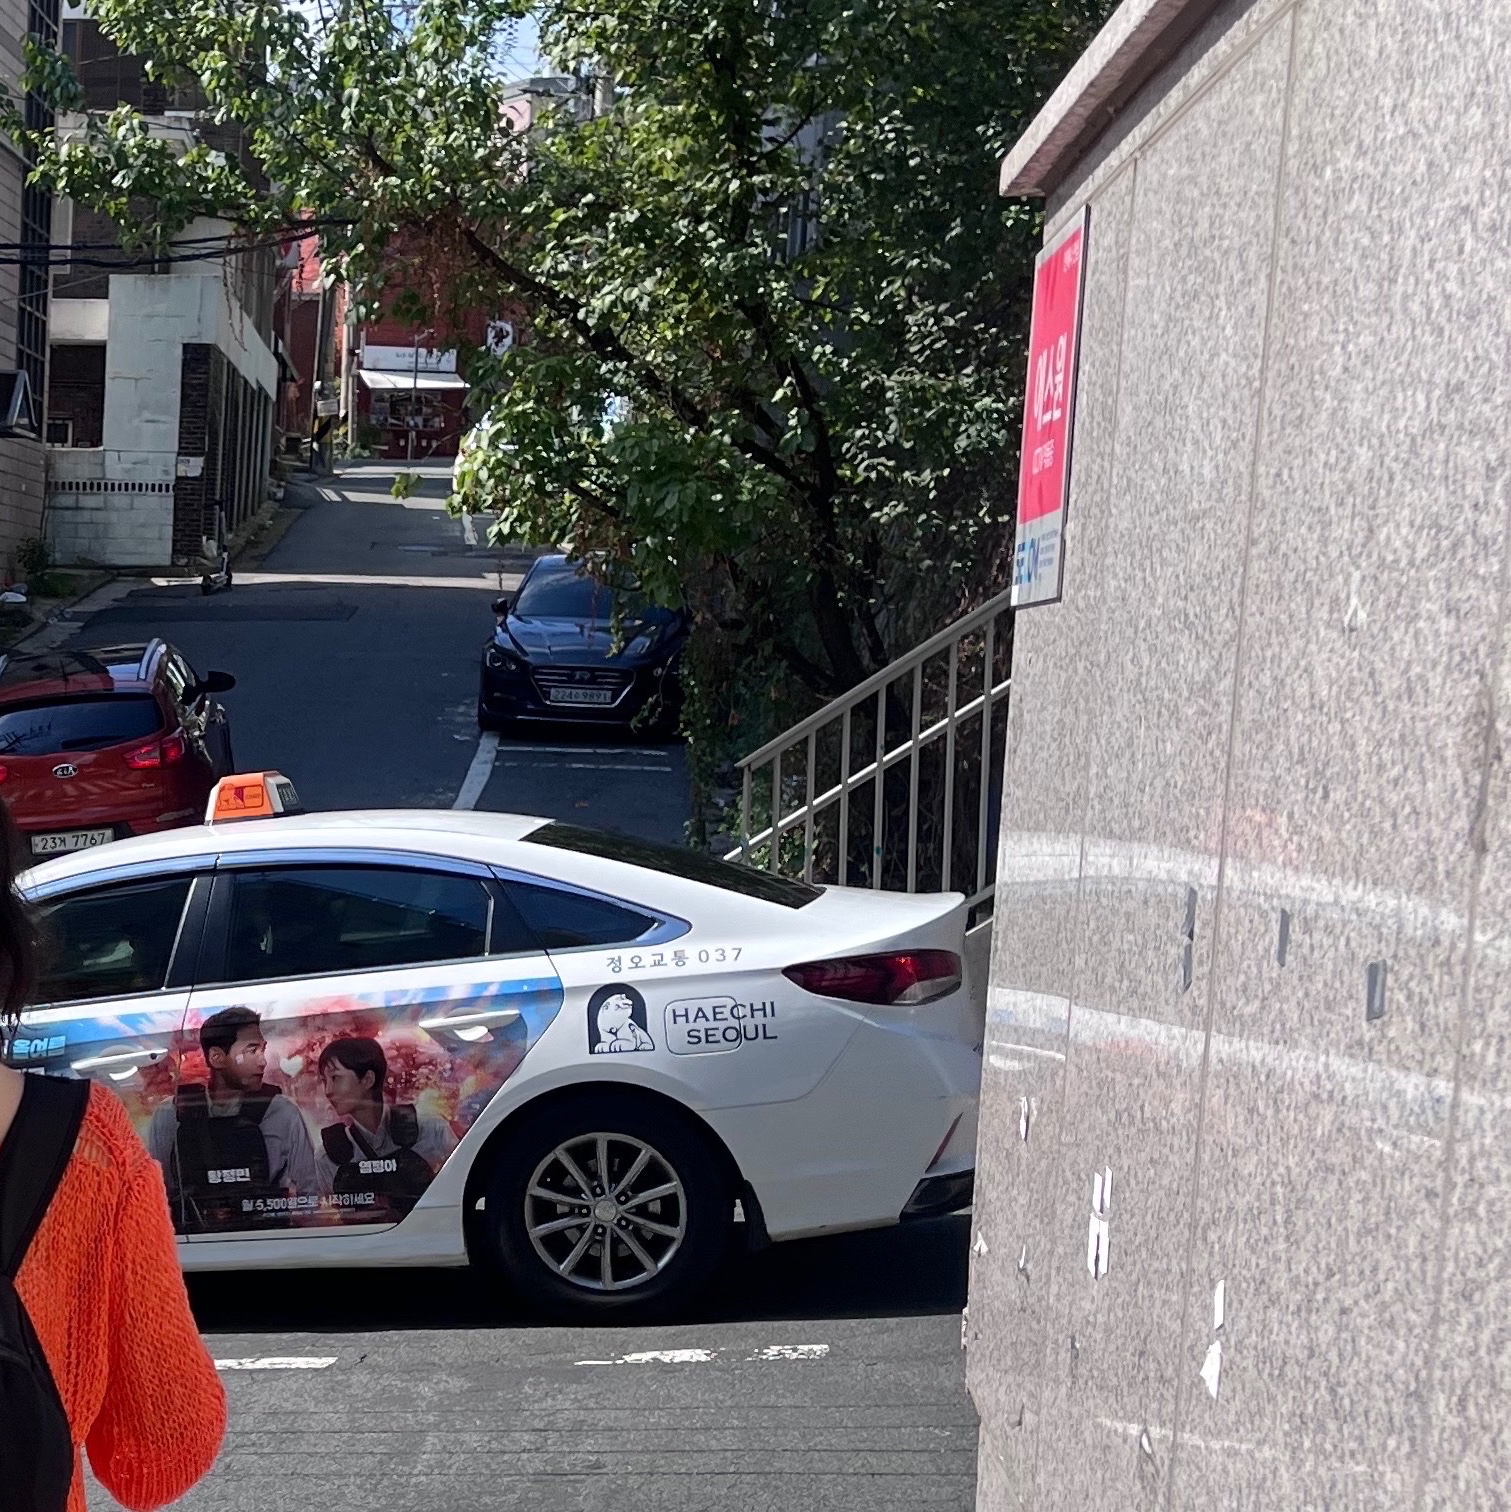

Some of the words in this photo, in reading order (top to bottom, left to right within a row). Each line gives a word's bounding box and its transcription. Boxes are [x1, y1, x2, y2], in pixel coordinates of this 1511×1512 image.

[71, 832, 106, 848] 7767
[605, 949, 690, 974] 정오교통
[697, 947, 744, 964] 037
[672, 1000, 776, 1025] HAECHI
[686, 1023, 778, 1046] SEOUL
